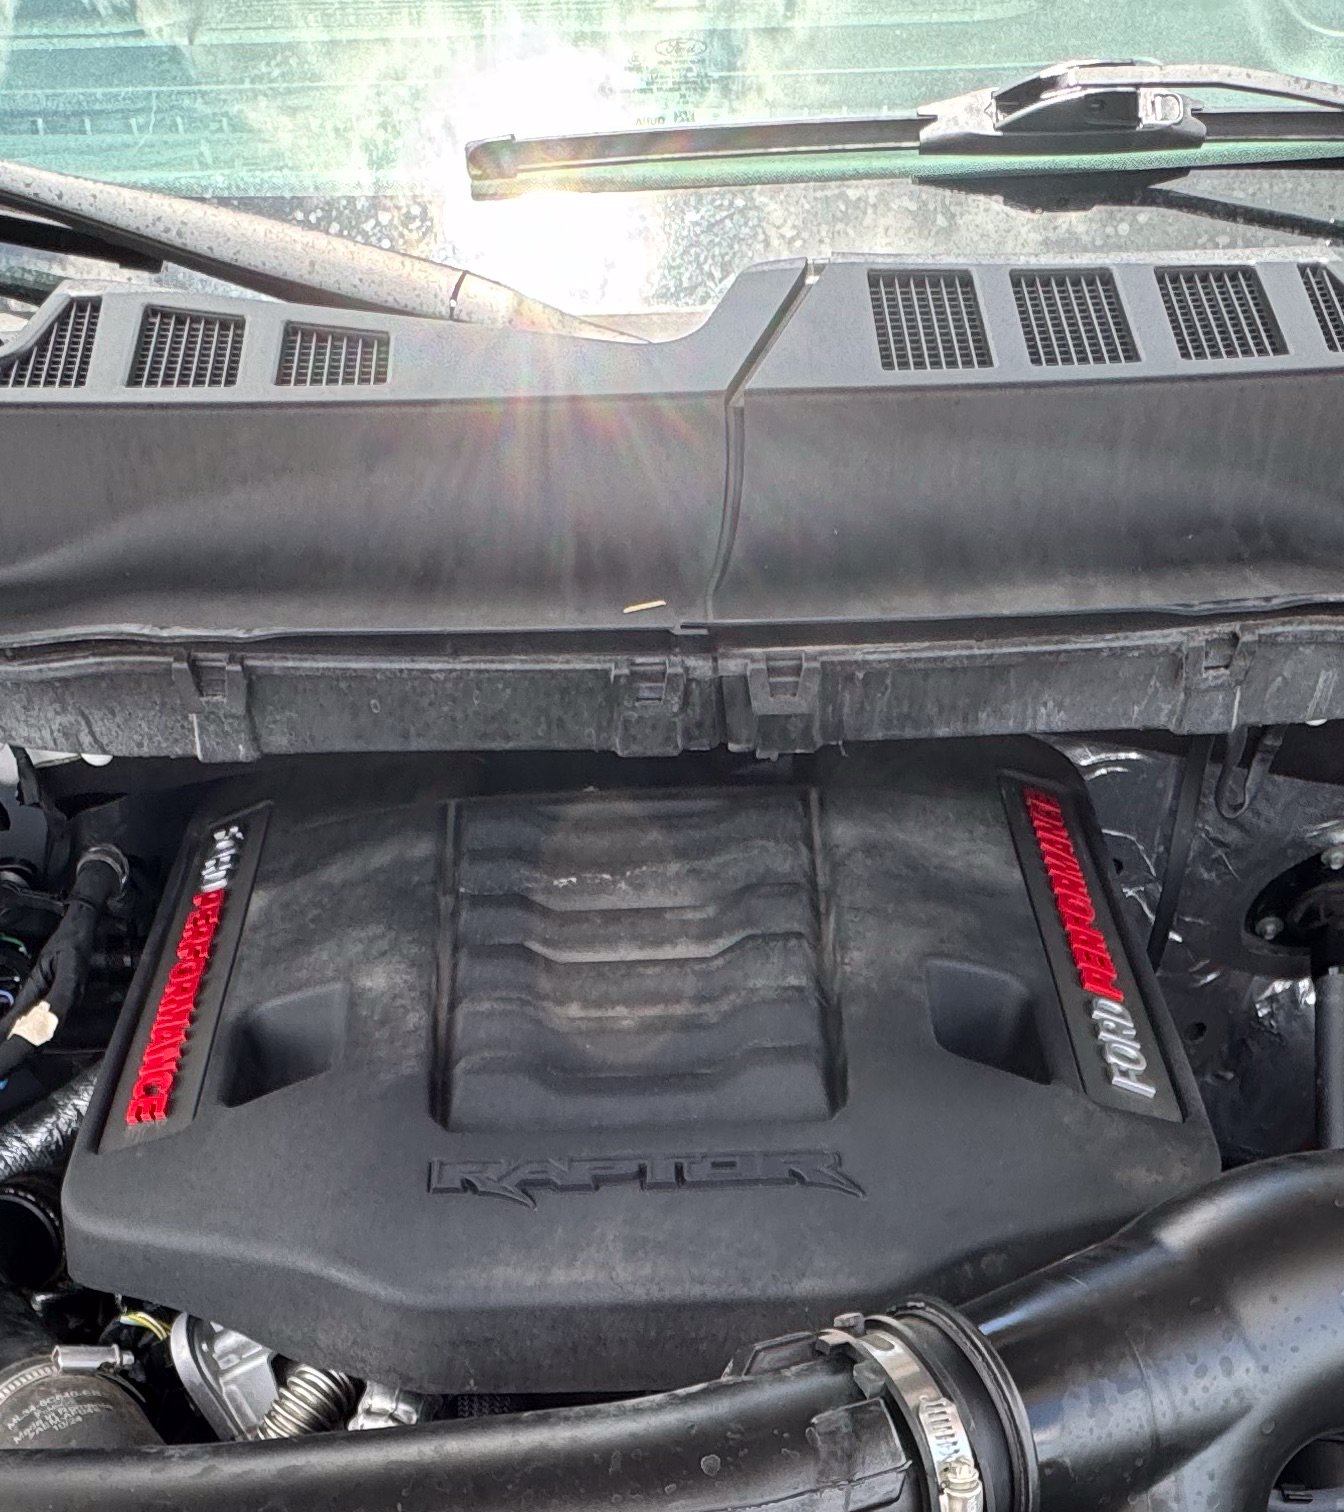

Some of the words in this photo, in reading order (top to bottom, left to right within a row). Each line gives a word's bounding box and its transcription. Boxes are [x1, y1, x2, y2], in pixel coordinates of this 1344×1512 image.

[1023, 785, 1125, 1003] PERFORMANCE
[126, 889, 225, 1125] PERFORMANCE
[1091, 998, 1157, 1098] FORD
[427, 1149, 867, 1211] RAPTOR
